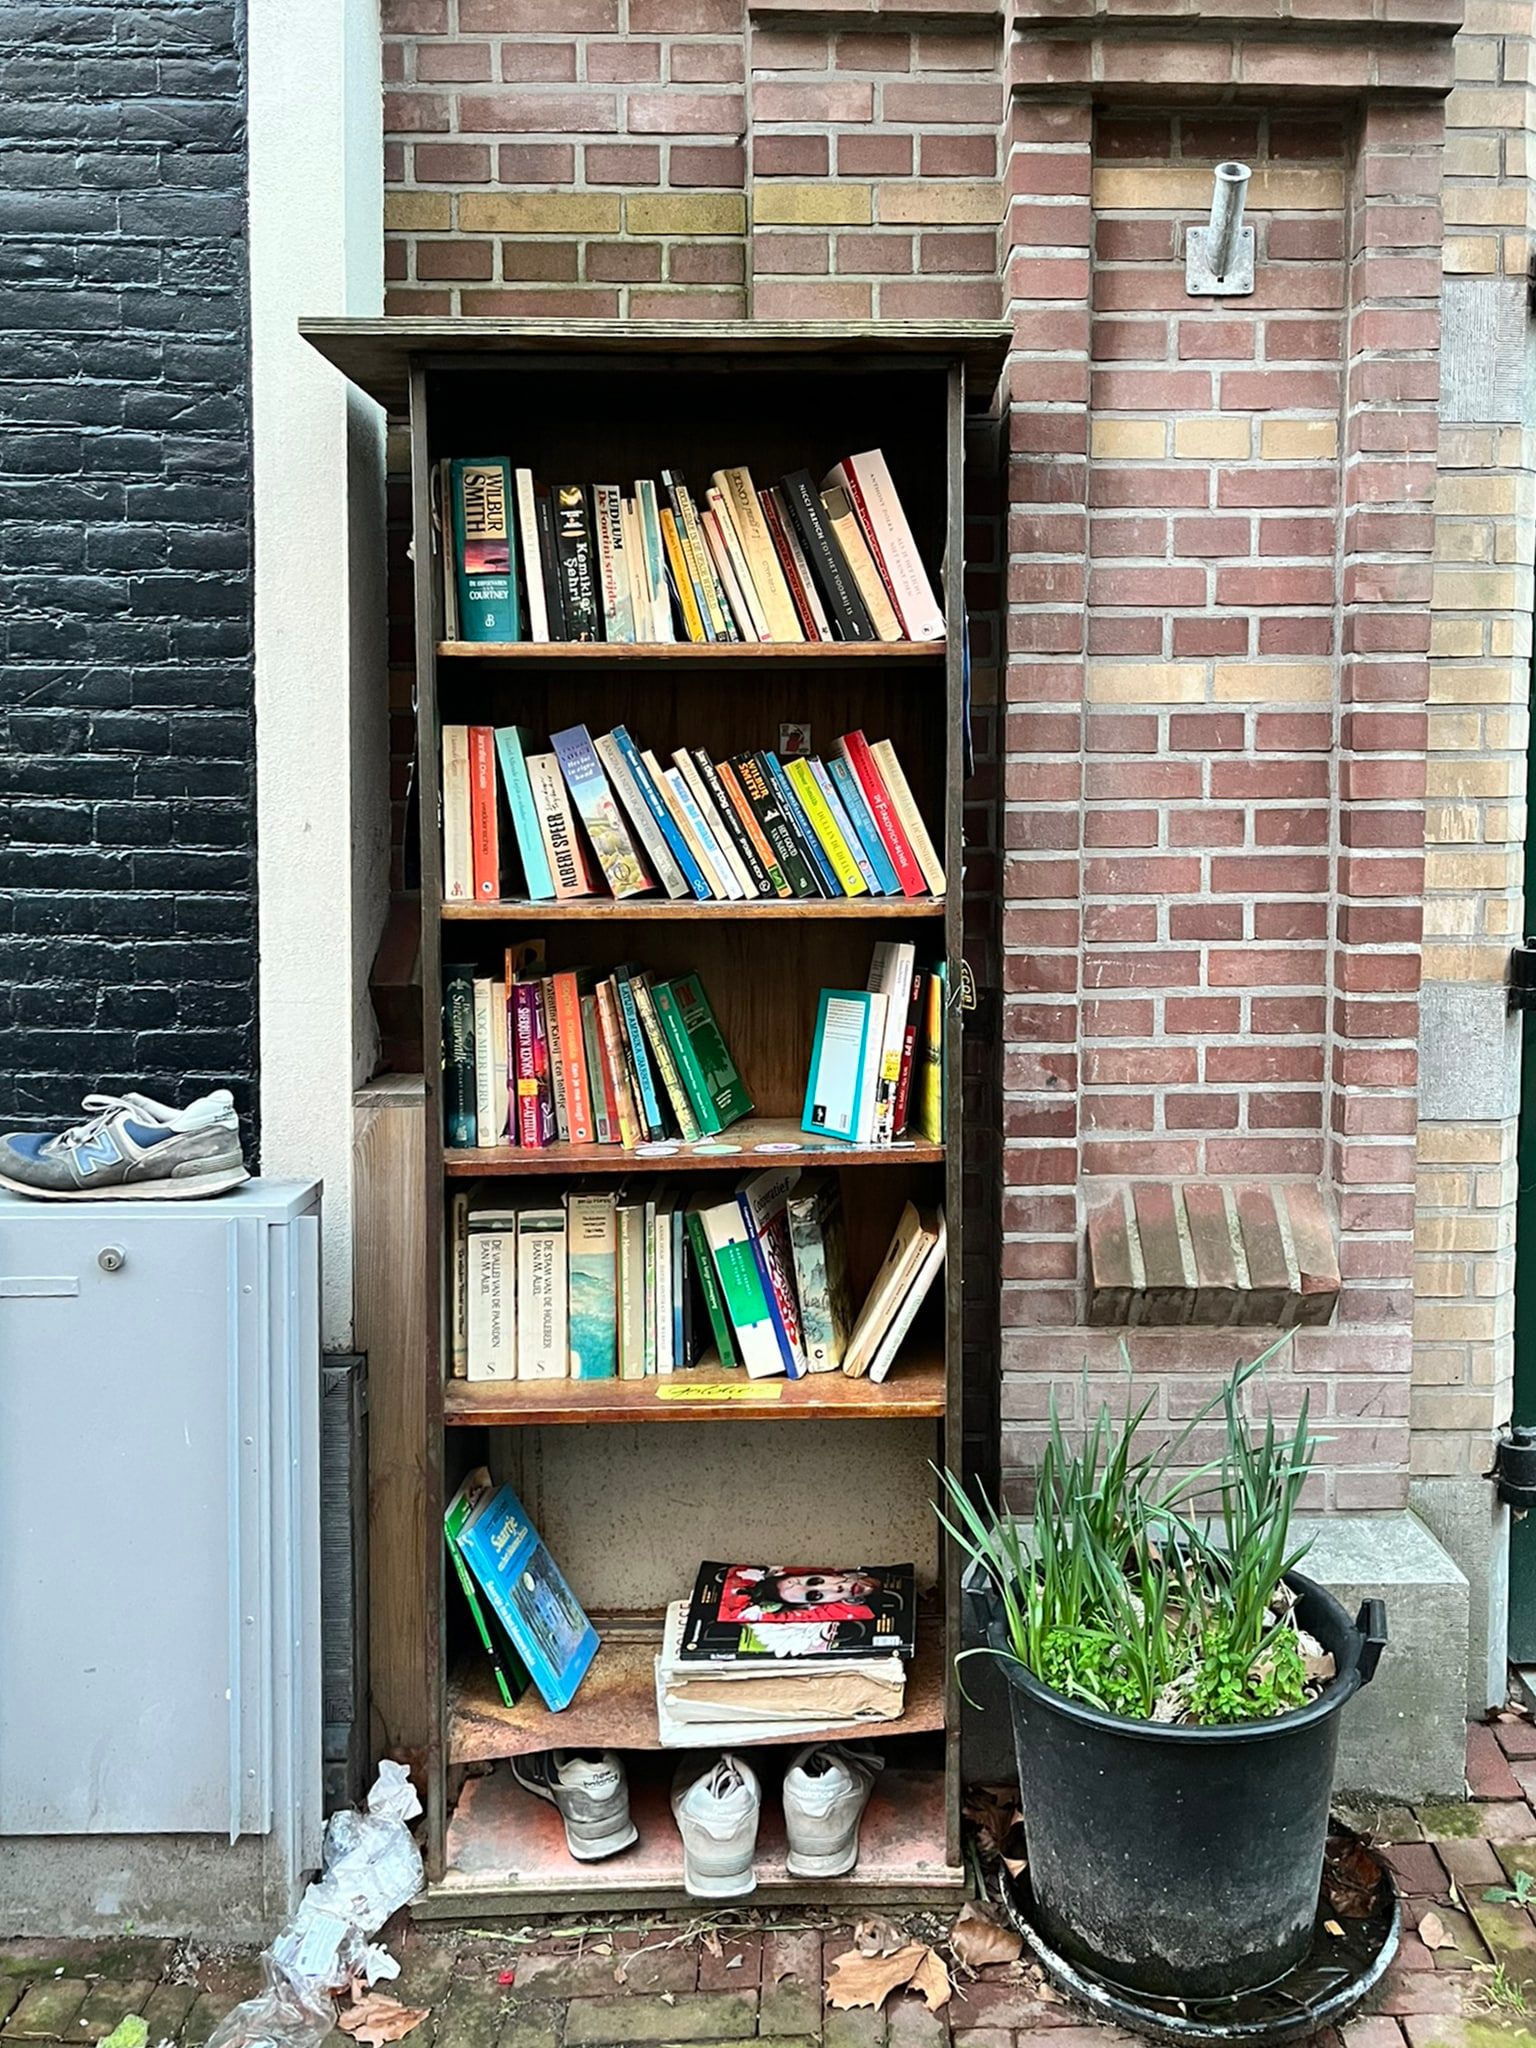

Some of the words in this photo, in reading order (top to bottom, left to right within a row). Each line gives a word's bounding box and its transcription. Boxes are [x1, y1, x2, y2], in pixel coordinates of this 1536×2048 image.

[464, 473, 486, 532] SMITH
[485, 474, 503, 530] WILBUR
[597, 489, 606, 507] De
[797, 483, 812, 507] NICCI
[607, 489, 623, 550] LUDLUM
[805, 507, 825, 539] FRENCH
[598, 509, 613, 559] Fontini
[820, 540, 831, 556] TOT
[574, 541, 595, 615] Kemikler
[825, 557, 838, 573] HET
[468, 588, 508, 601] COURTNEY
[602, 561, 619, 618] strijders
[830, 573, 851, 607] VOORBIJ
[844, 606, 853, 615] IS
[703, 764, 716, 779] de
[737, 761, 761, 801] SMITH
[746, 758, 770, 799] WILBUR
[793, 762, 809, 785] Wilbur
[804, 784, 819, 806] Smith
[708, 775, 730, 810] hartog
[545, 811, 570, 848] SPEER
[777, 823, 789, 838] HET
[553, 847, 578, 888] ALBERT
[451, 994, 467, 1063] Sneeuwvalk
[476, 1007, 487, 1035] NOG
[550, 1024, 560, 1054] Kalwij
[627, 1016, 643, 1054] AMERIKA
[476, 1037, 489, 1070] MEER
[477, 1072, 490, 1114] EIEREN
[480, 1240, 490, 1260] JEAN
[492, 1240, 502, 1251] DE
[531, 1240, 542, 1260] JEAN
[544, 1240, 553, 1251] DE
[492, 1252, 501, 1278] VALLEI
[543, 1252, 553, 1275] STAM
[481, 1274, 490, 1296] AUEL
[492, 1279, 501, 1296] VAN
[532, 1274, 541, 1296] AUEL
[543, 1277, 552, 1294] VAN
[492, 1298, 501, 1308] DE
[543, 1296, 552, 1307] DE
[492, 1310, 501, 1348] PAARDEN
[583, 1773, 618, 1788] balance
[592, 1771, 611, 1780] new
